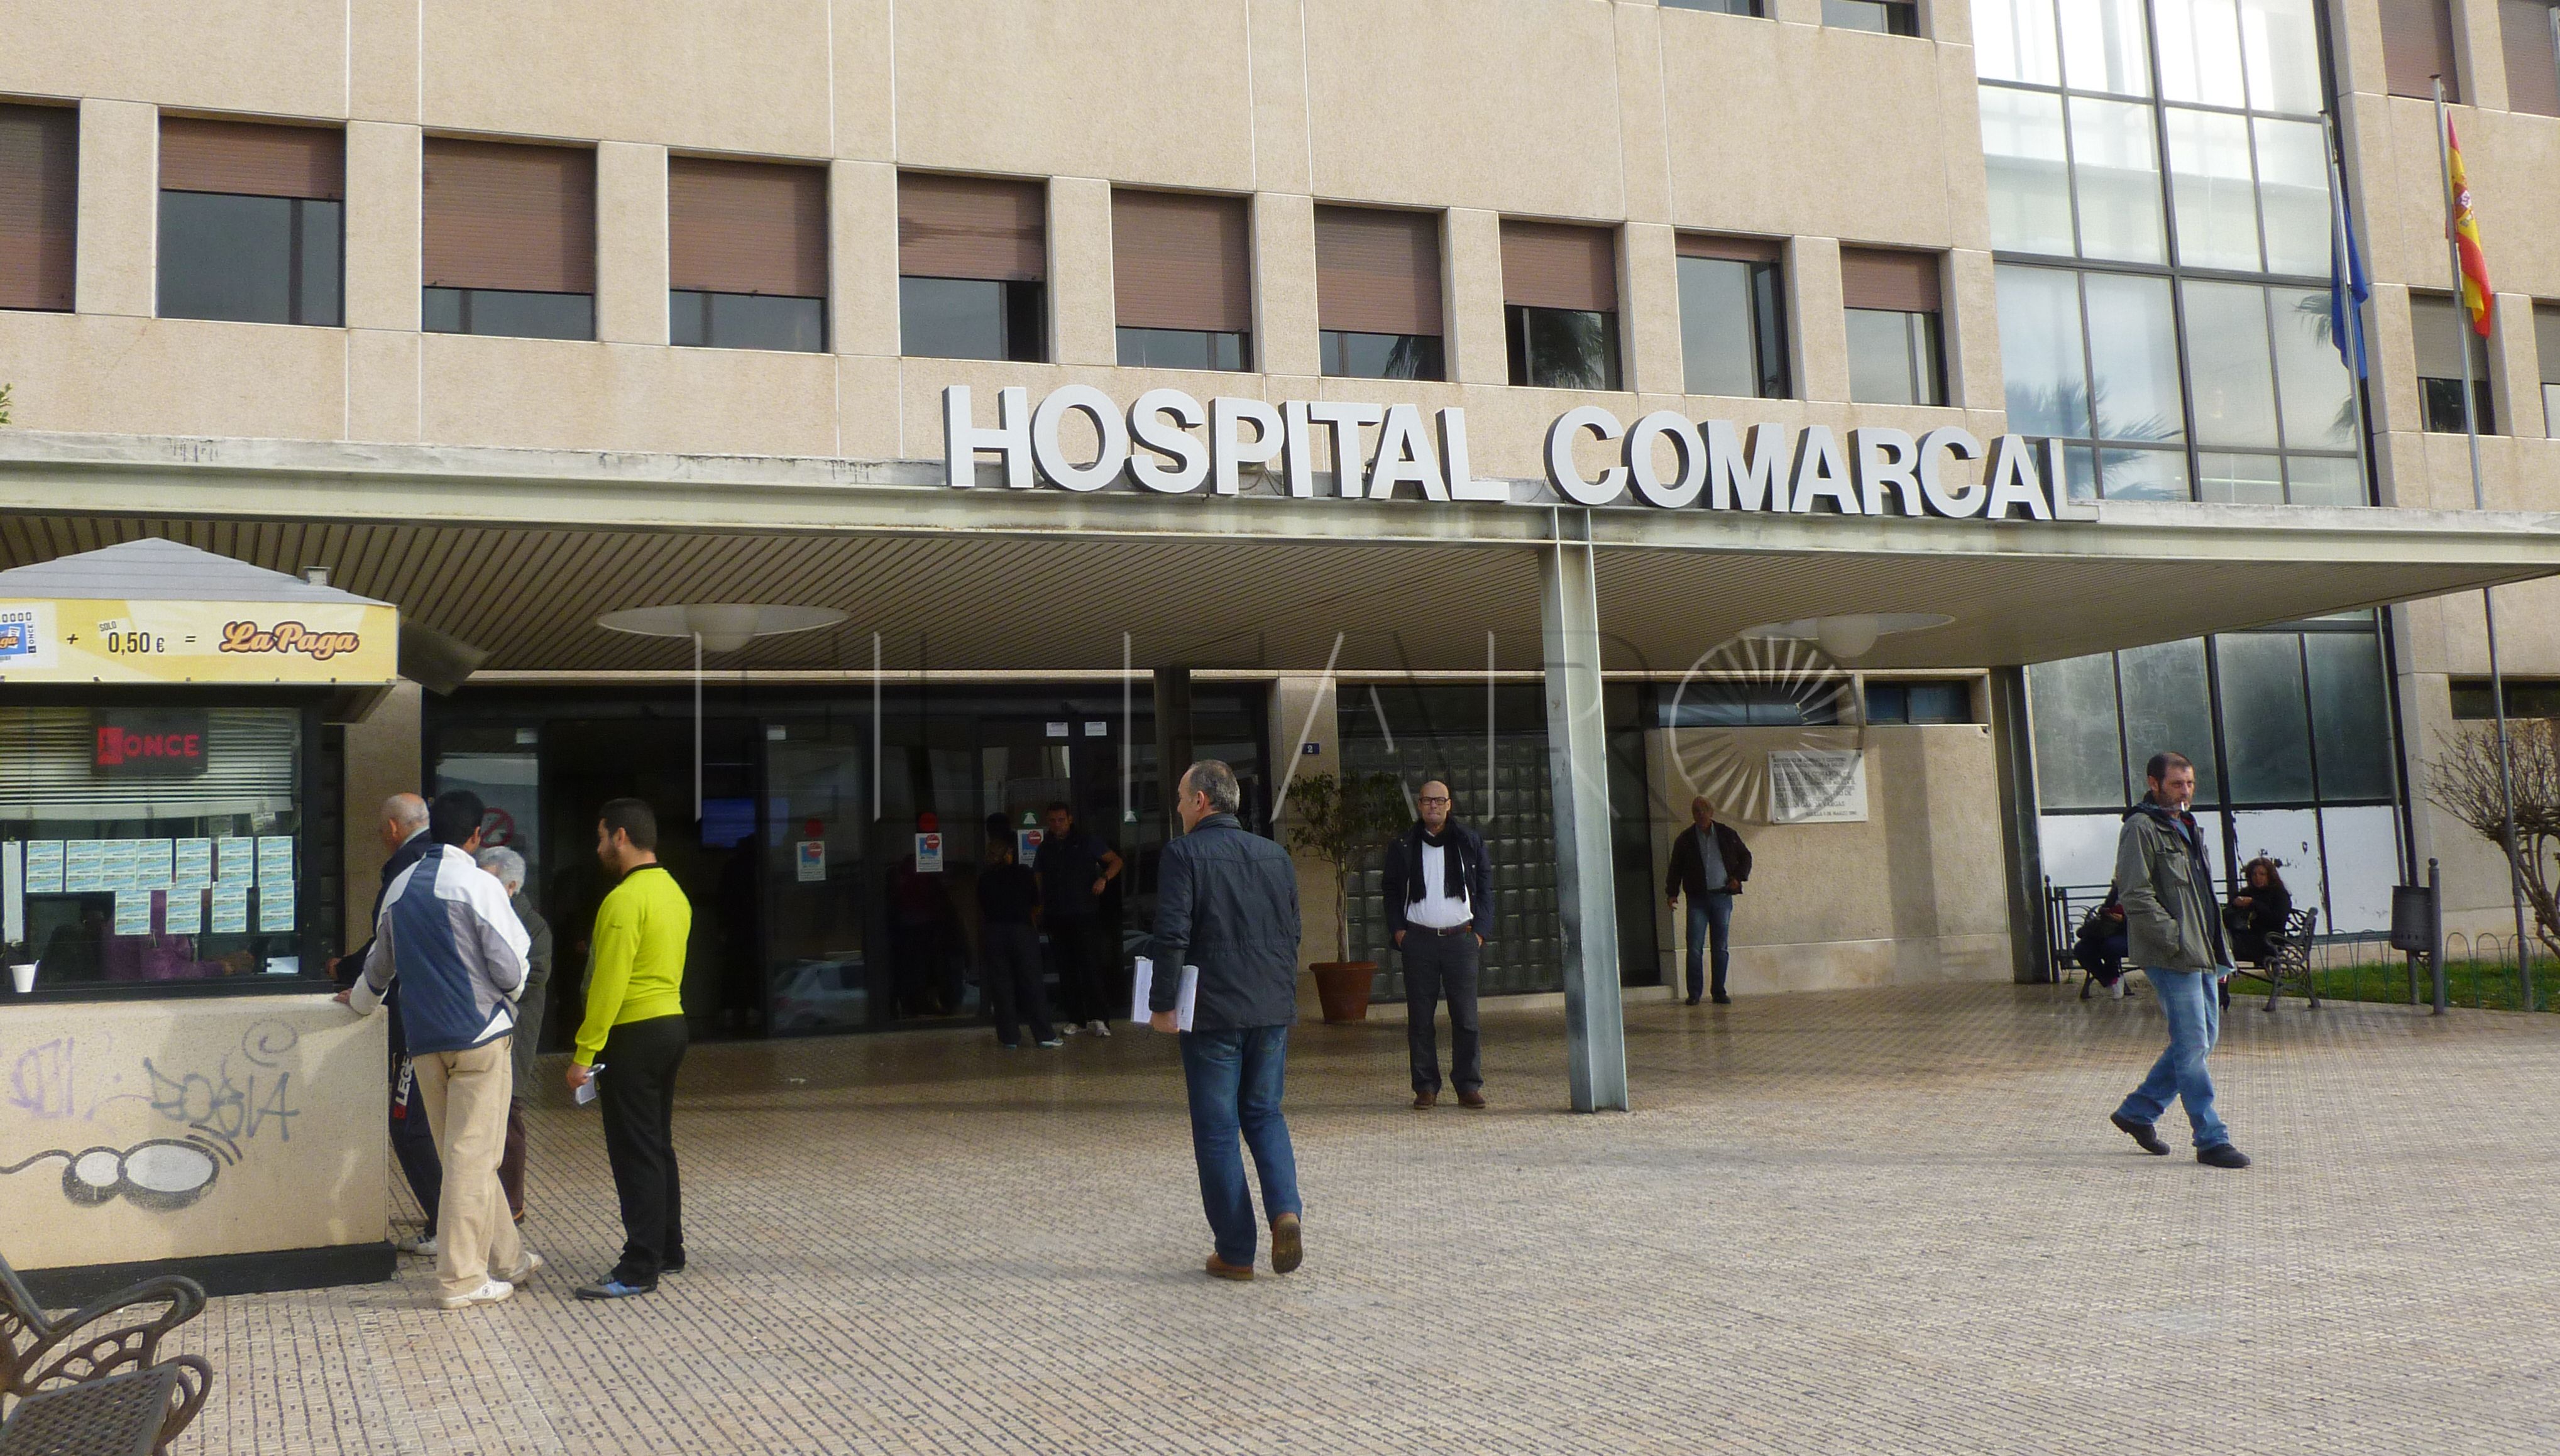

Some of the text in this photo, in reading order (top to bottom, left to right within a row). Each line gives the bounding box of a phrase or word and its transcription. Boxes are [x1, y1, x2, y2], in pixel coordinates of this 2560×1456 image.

[942, 384, 2100, 522] HOSPITAL COMARCAL
[99, 620, 118, 632] SOLO
[219, 620, 360, 661] La Paga
[108, 632, 150, 655] 0,50
[126, 733, 201, 758] ONCE
[395, 1048, 414, 1107] LEGE
